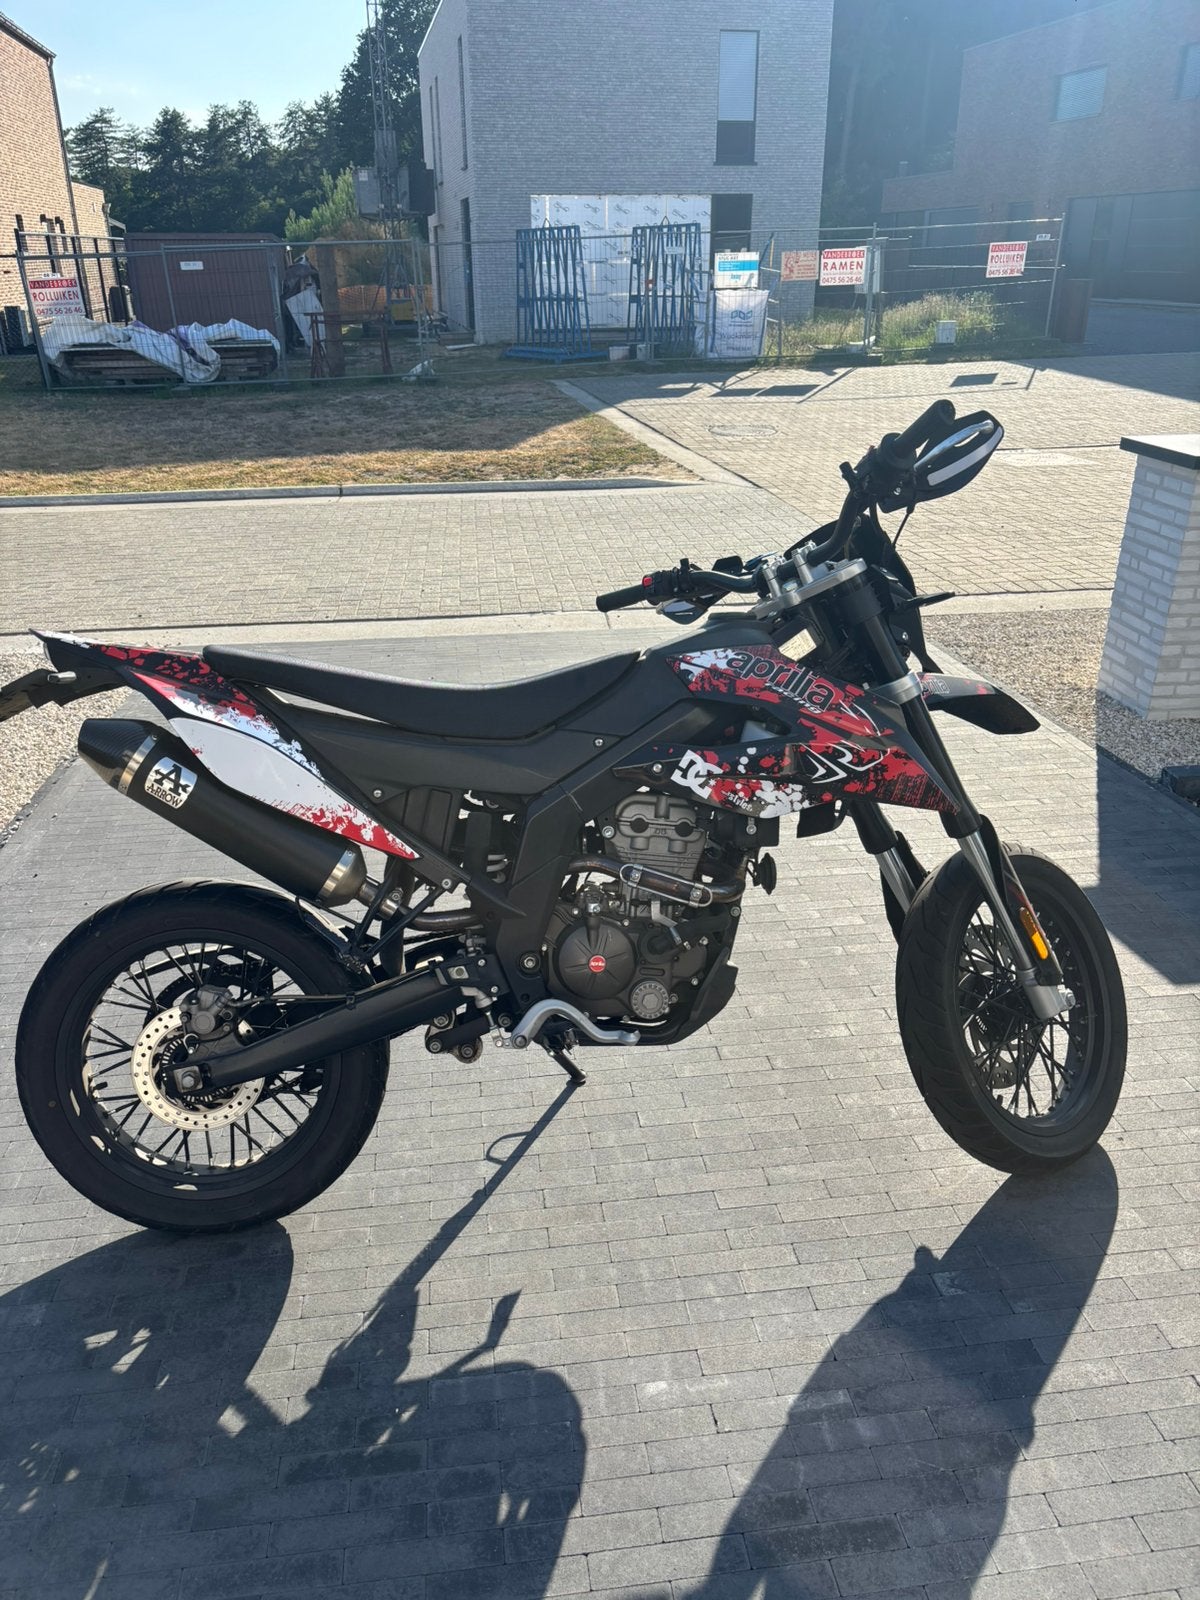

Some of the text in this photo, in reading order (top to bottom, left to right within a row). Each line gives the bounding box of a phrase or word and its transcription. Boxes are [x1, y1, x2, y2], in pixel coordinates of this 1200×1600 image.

[824, 250, 864, 258] VANDEBROEK
[990, 253, 1024, 264] ROLLUIKEN
[822, 261, 864, 271] RAMEN
[988, 268, 1001, 276] 0475
[29, 280, 77, 288] VANDEBROEK
[822, 276, 837, 284] 0475
[855, 275, 862, 283] 46
[32, 290, 79, 302] ROLLUIKEN
[36, 307, 53, 315] 0475
[54, 307, 63, 315] 56
[64, 306, 73, 314] 26
[726, 651, 835, 712] aprilia
[147, 783, 182, 807] ARROW
